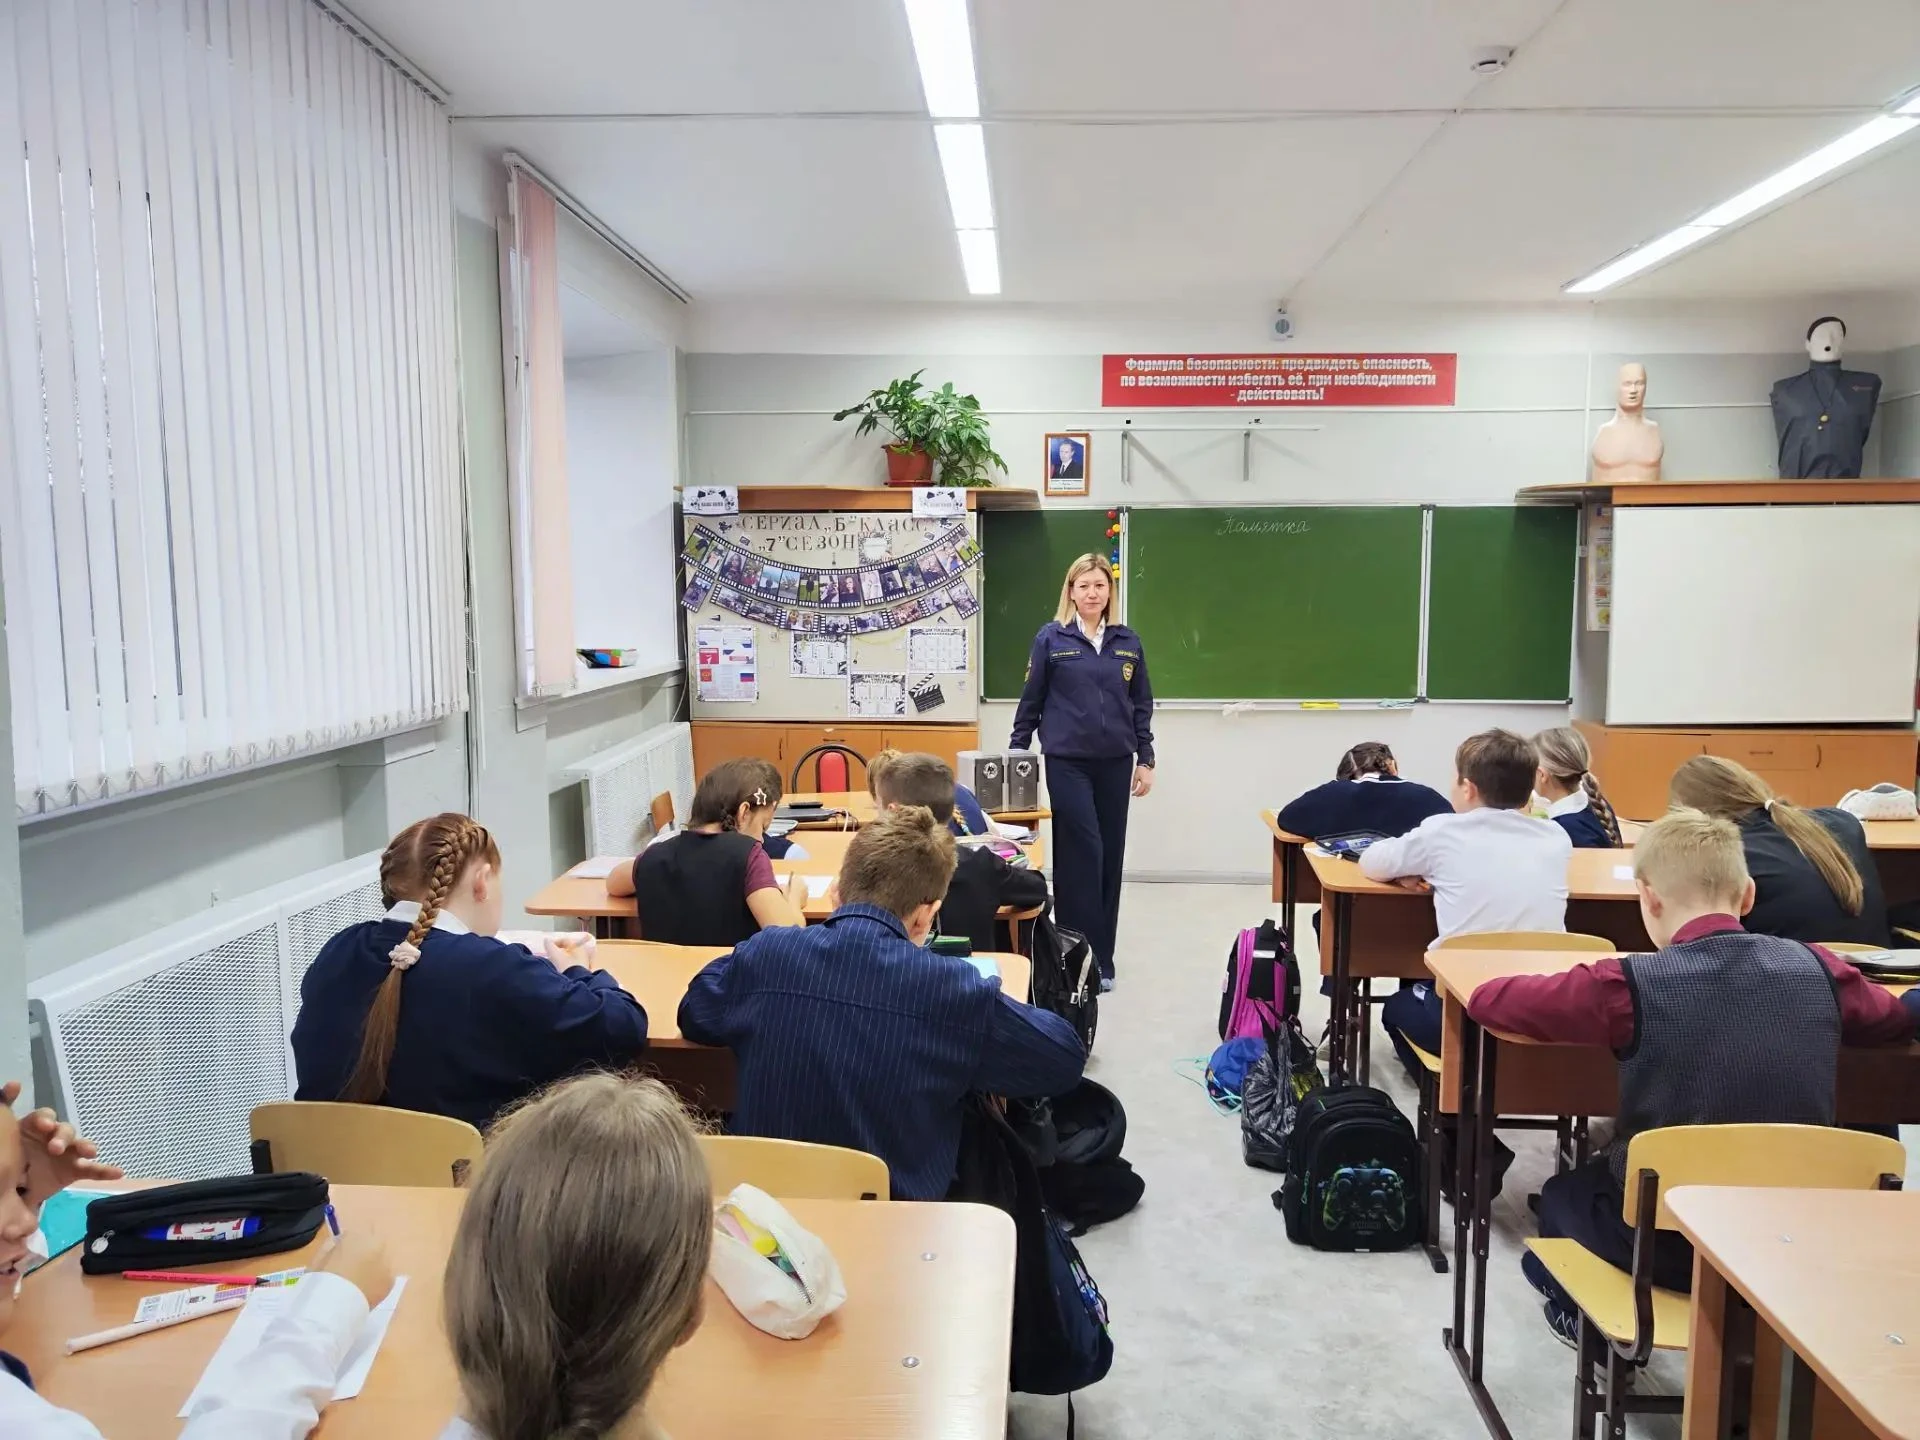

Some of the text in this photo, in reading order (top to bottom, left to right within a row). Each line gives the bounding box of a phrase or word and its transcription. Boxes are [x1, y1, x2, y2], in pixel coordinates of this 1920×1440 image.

[1125, 357, 1433, 371] Формула безопасности: предвидеть опасность,
[1120, 373, 1436, 387] по возможности избегать её, при необходимости
[1237, 387, 1324, 402] действовать!
[786, 535, 854, 550] СЕЗОН
